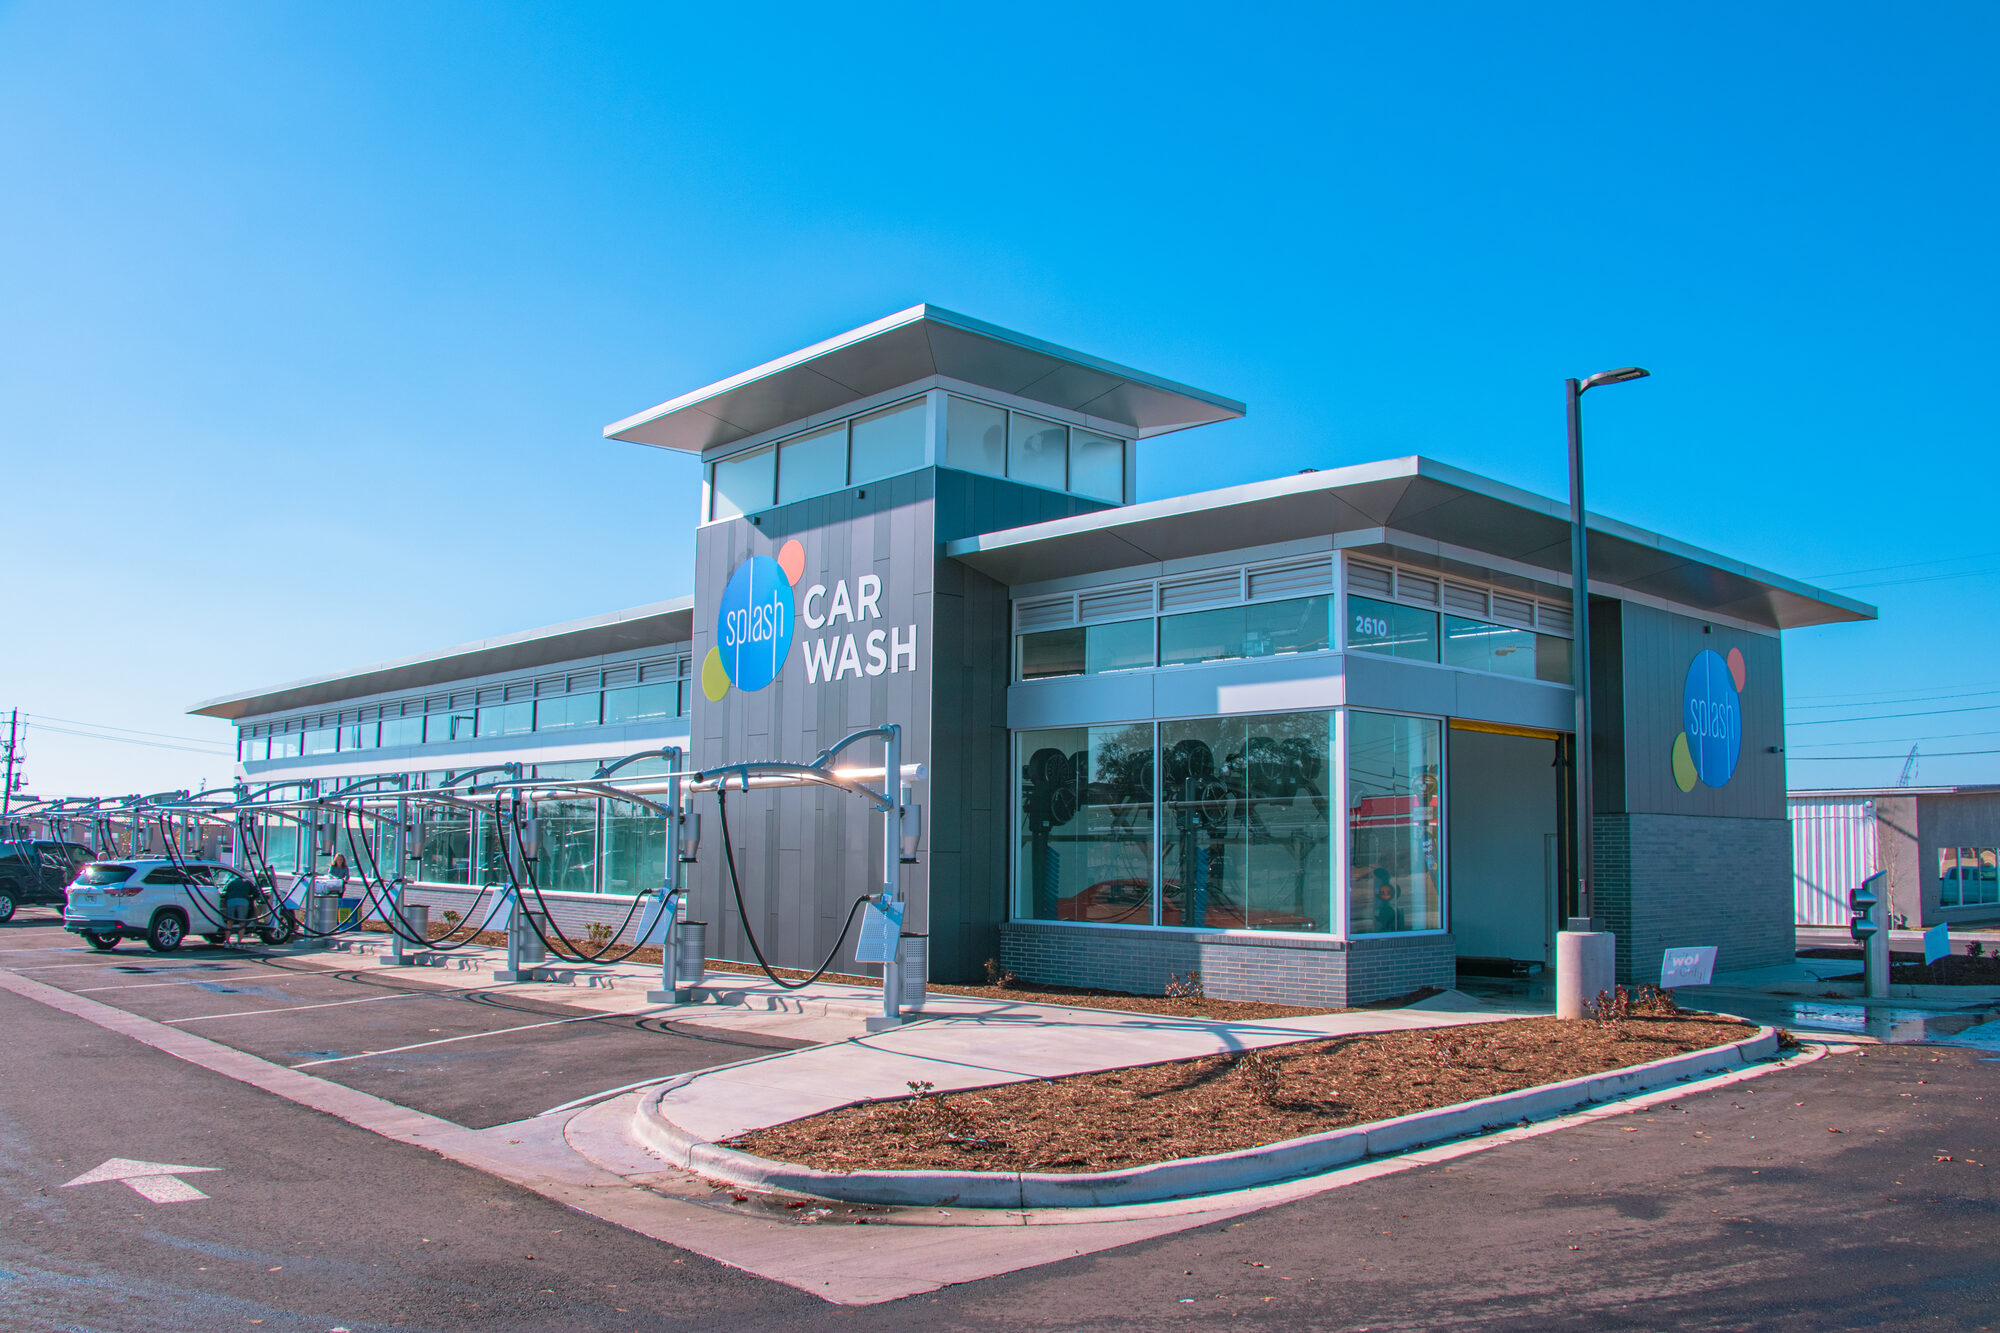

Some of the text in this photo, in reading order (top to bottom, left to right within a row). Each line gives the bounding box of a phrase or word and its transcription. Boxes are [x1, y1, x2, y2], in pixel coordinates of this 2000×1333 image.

[803, 574, 882, 630] CAR
[1355, 615, 1388, 637] 2610
[802, 624, 918, 684] WASH
